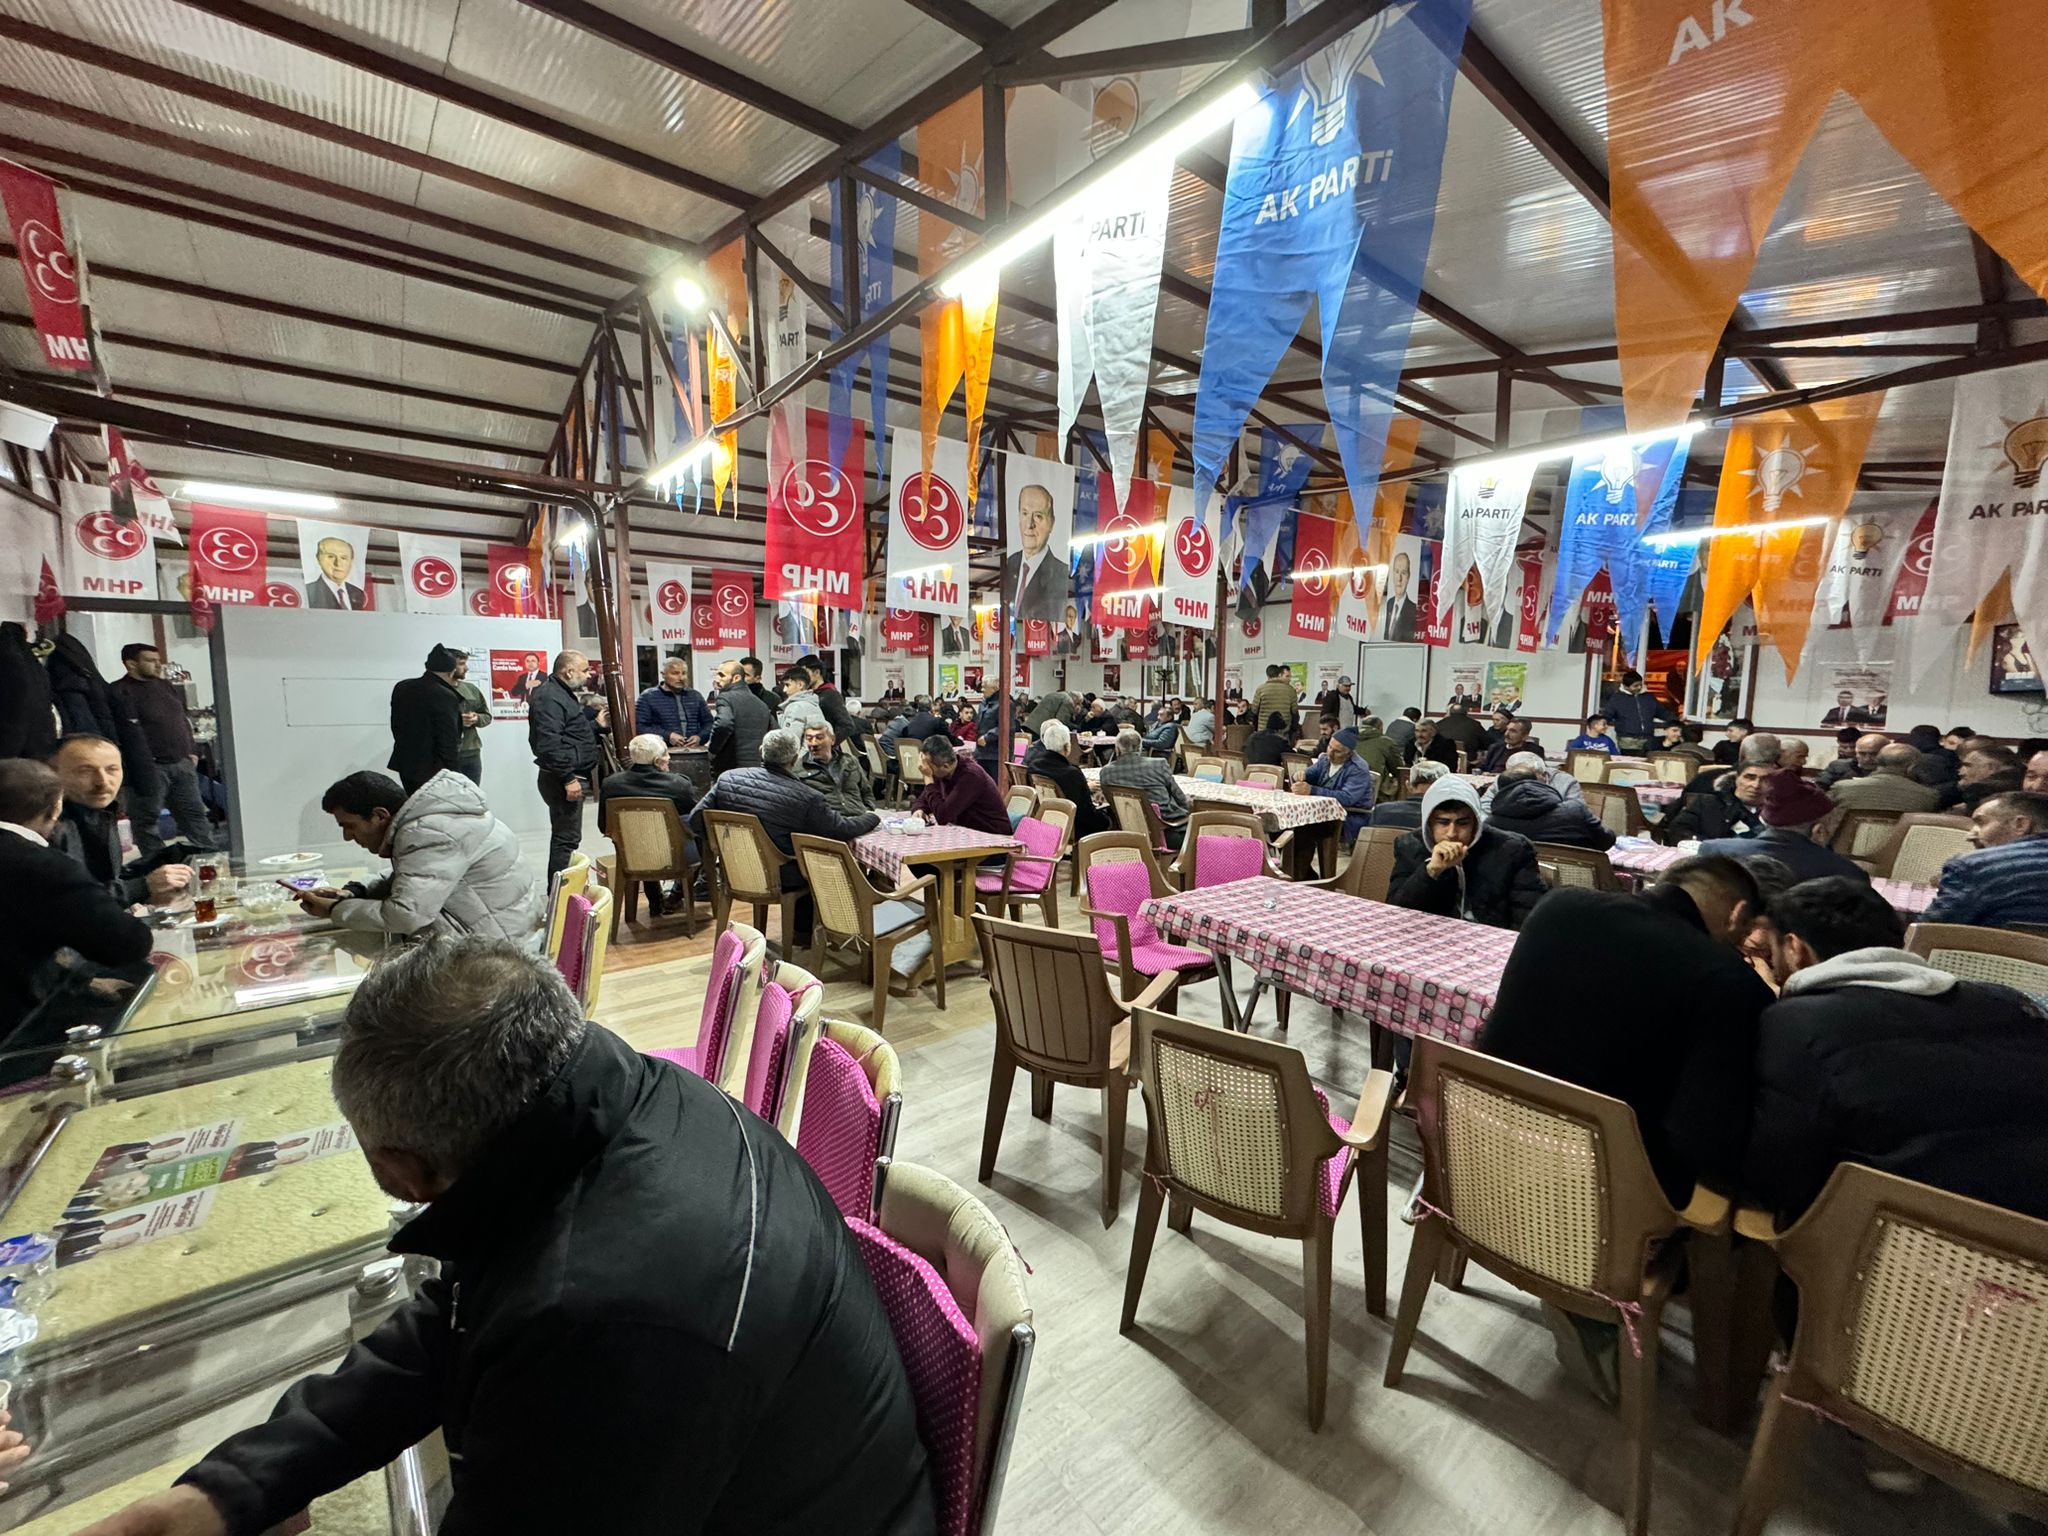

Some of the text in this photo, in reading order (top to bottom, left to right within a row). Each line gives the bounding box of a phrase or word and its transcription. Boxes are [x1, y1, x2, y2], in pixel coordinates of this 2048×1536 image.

[1667, 0, 1755, 65] AK
[1254, 184, 1300, 225] AK
[778, 331, 800, 347] ART
[45, 333, 92, 361] MH
[1968, 500, 2048, 520] AK PAR
[1575, 513, 1638, 526] AK PART
[1829, 565, 1846, 574] AK
[83, 577, 143, 594] MHP
[203, 585, 255, 603] MHP
[1587, 591, 1614, 604] MH
[1149, 612, 1161, 620] MH
[719, 628, 747, 639] MHP
[890, 631, 913, 641] MHP
[987, 642, 1000, 650] MH
[1027, 640, 1046, 649] MHP
[1129, 645, 1145, 653] MHP
[1244, 646, 1261, 654] MHP
